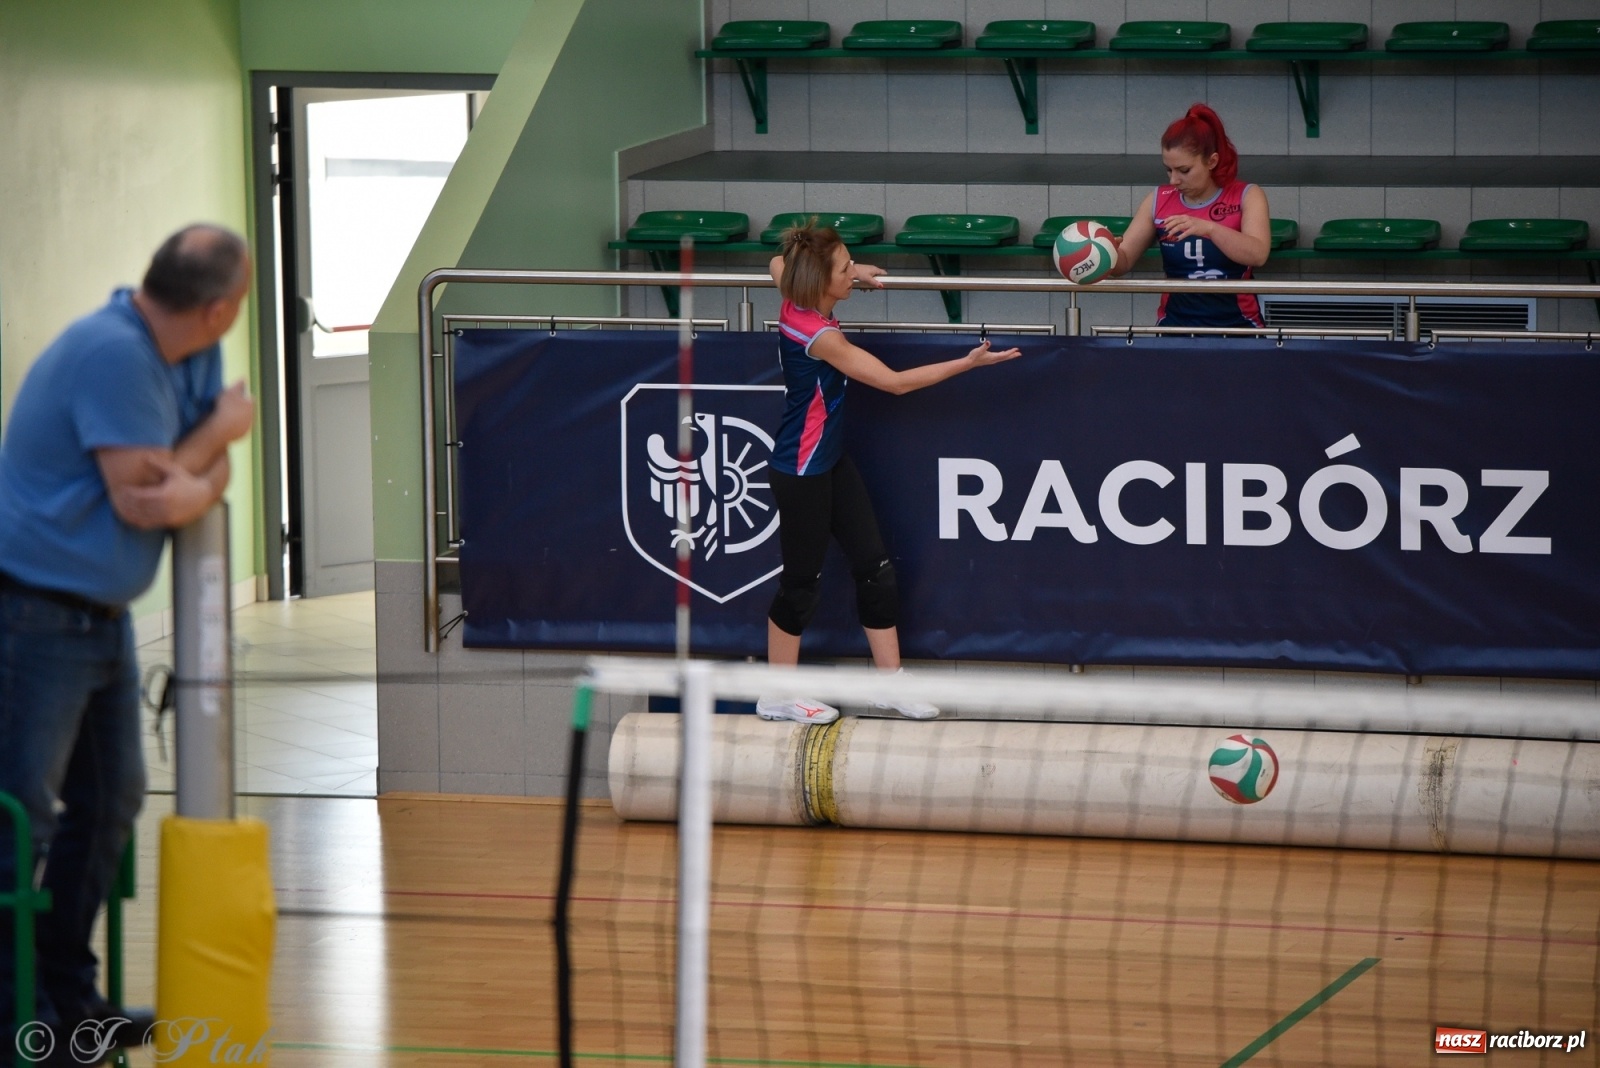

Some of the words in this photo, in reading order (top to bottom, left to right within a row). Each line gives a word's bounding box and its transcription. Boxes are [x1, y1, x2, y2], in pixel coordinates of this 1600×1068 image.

[1184, 239, 1204, 267] 4
[1073, 259, 1095, 276] MECZ
[938, 433, 1552, 556] RACIBÓRZ
